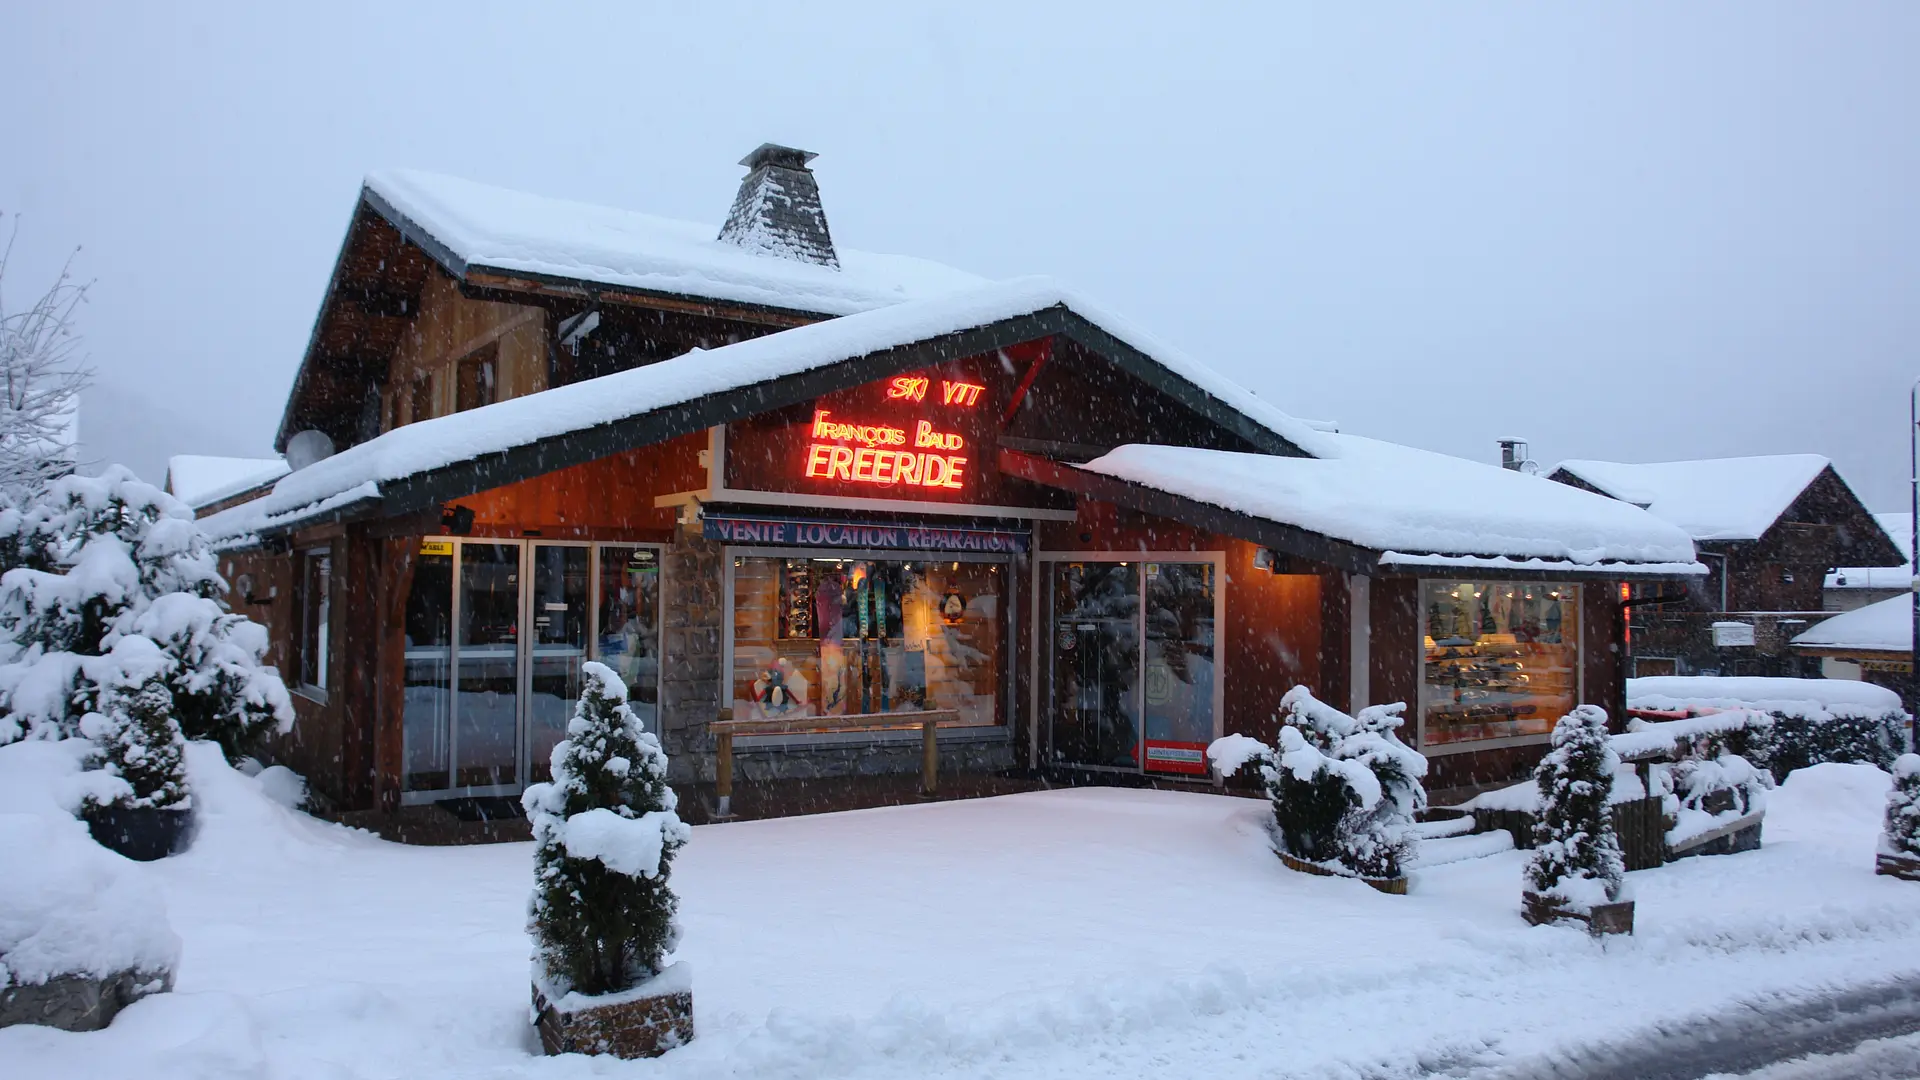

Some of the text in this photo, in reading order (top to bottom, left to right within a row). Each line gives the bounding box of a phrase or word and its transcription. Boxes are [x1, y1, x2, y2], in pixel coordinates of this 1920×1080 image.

[887, 376, 986, 406] SKI VTT
[805, 443, 968, 489] FREERIDE
[716, 519, 785, 543] VENTE
[796, 523, 898, 547] LOCATION
